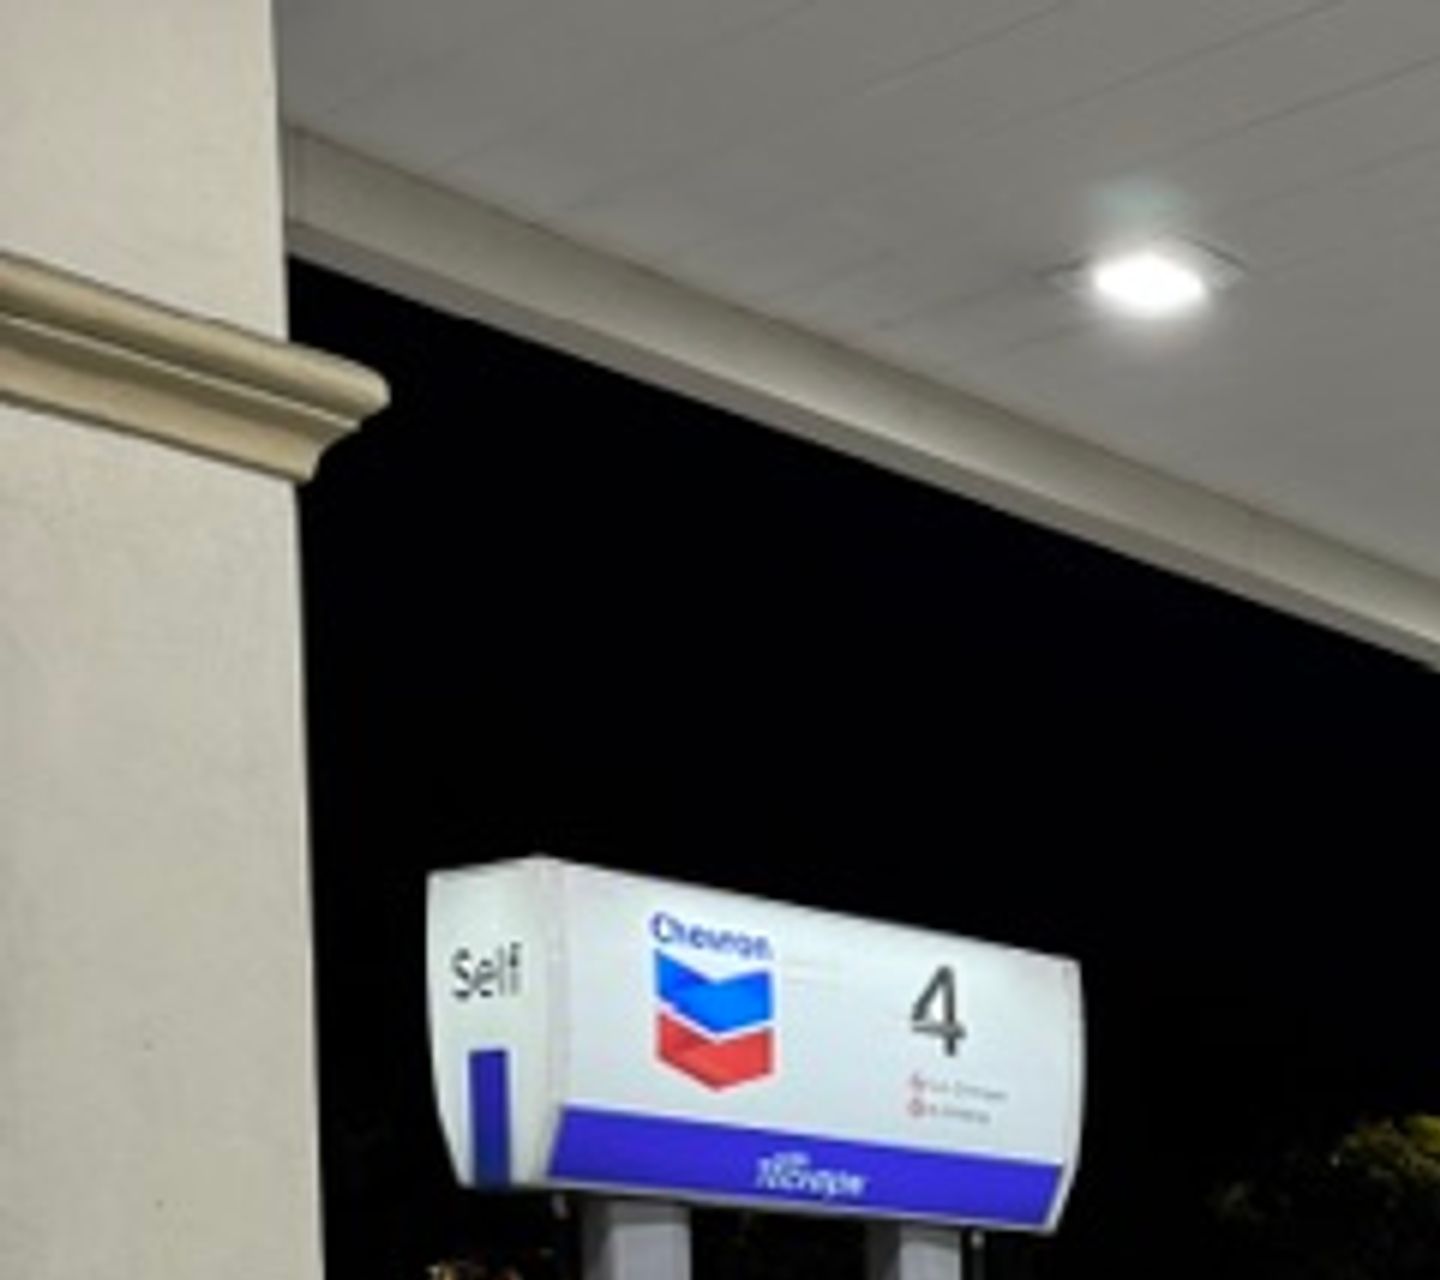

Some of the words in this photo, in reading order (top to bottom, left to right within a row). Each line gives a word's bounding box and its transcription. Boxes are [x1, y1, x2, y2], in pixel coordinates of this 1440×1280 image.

[648, 911, 775, 961] Chevron
[450, 941, 522, 1002] Self
[911, 965, 967, 1057] 4
